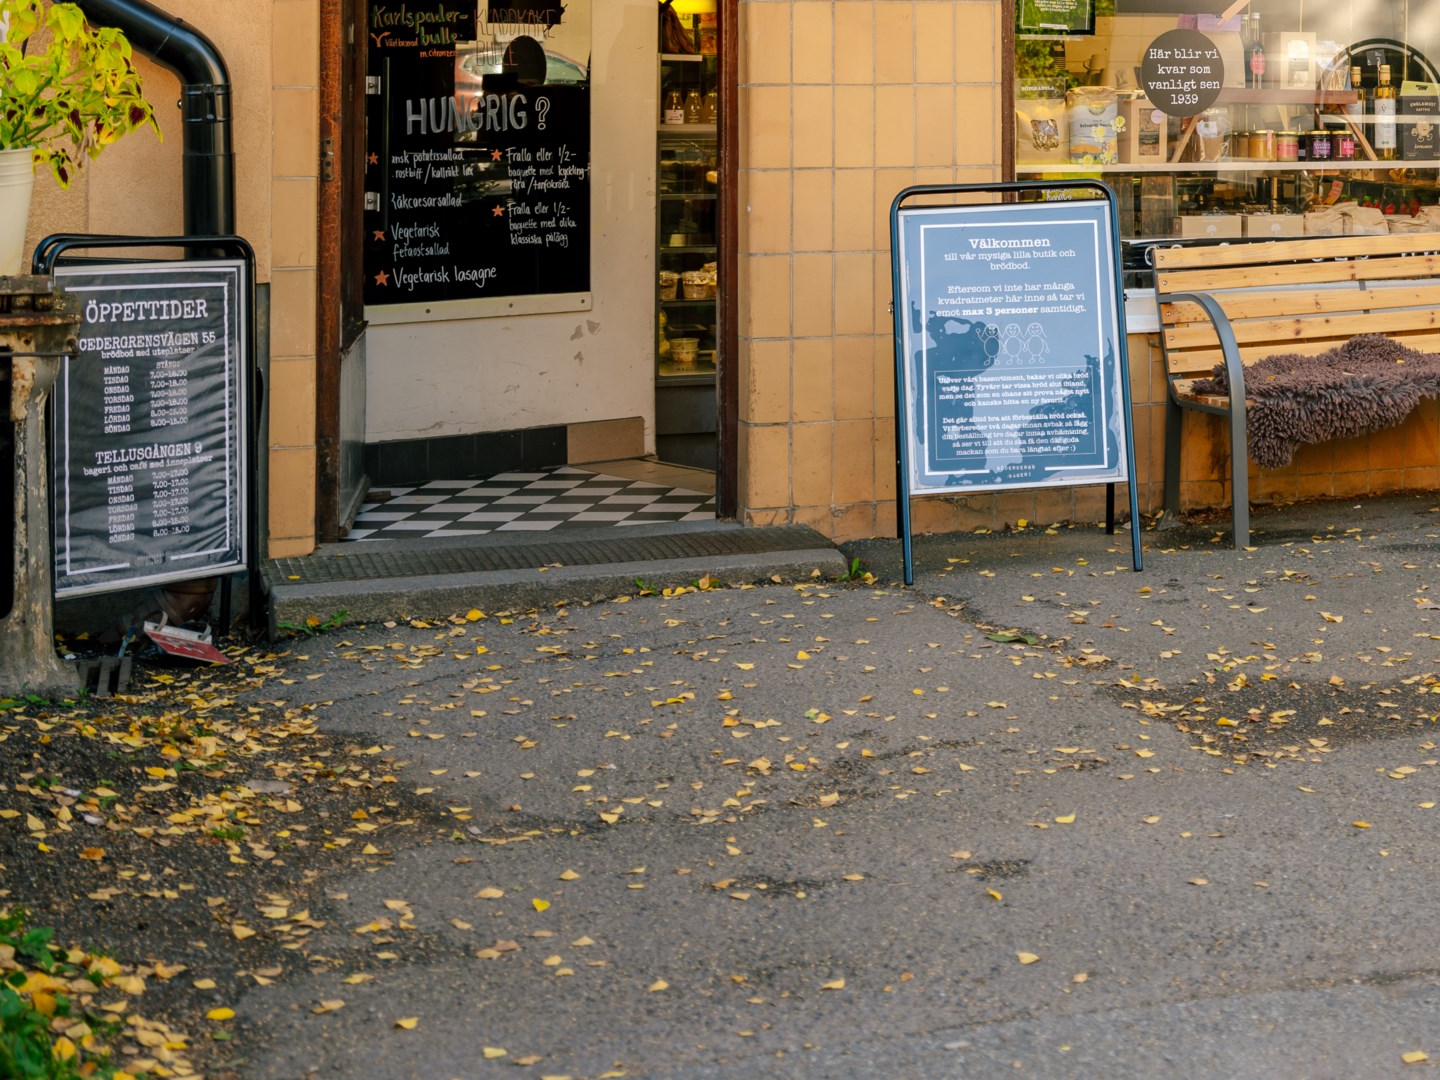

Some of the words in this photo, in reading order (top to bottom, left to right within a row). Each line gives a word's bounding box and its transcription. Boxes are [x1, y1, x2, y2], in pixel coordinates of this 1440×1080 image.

[1149, 49, 1170, 59] Här
[1174, 49, 1202, 59] blir
[1205, 49, 1219, 59] vi
[1157, 65, 1186, 75] kvar
[1190, 65, 1211, 74] som
[1148, 80, 1197, 92] vanligt
[1200, 80, 1220, 89] sen
[1170, 94, 1198, 105] 1939
[406, 94, 527, 135] HUNGRIG
[505, 147, 531, 164] Fralla
[536, 148, 552, 161] eller
[507, 202, 531, 217] Fralla
[534, 202, 549, 214] eller
[541, 217, 556, 227] med
[391, 222, 440, 245] Vegetarisk
[969, 238, 1051, 248] Välkommen
[393, 243, 450, 261] fetaostsallad
[978, 252, 1011, 261] mysiga
[393, 267, 450, 291] Vegetarisk
[454, 266, 497, 288] lasagne
[948, 285, 990, 293] Eftersom
[1044, 282, 1075, 291] många
[938, 295, 1003, 305] kvadratmeter
[1047, 293, 1058, 301] så
[86, 299, 208, 323] ÖPPETTIDER
[995, 308, 1038, 316] personer
[1041, 305, 1087, 314] samtidigt.
[80, 332, 198, 351] CEDERGRENSVÄGEN
[202, 332, 216, 343] 55
[101, 350, 134, 359] brödbod
[152, 347, 195, 357] uteplatser
[104, 366, 129, 374] MÅNDAG
[104, 386, 129, 394] ONSDAG
[104, 395, 134, 404] TORSDAG
[104, 405, 130, 414] FREDAG
[104, 415, 130, 423] LÖRDAG
[105, 425, 130, 433] SÖNDAG
[96, 443, 191, 465] TELLUSGÅNGEN
[195, 441, 202, 453] 9
[83, 467, 110, 476] bageri
[114, 464, 128, 472] och
[130, 462, 147, 470] café
[150, 460, 163, 468] med
[108, 475, 133, 484] MÅNDAG
[108, 485, 133, 494] TISDAG
[108, 495, 134, 504] ONSDAG
